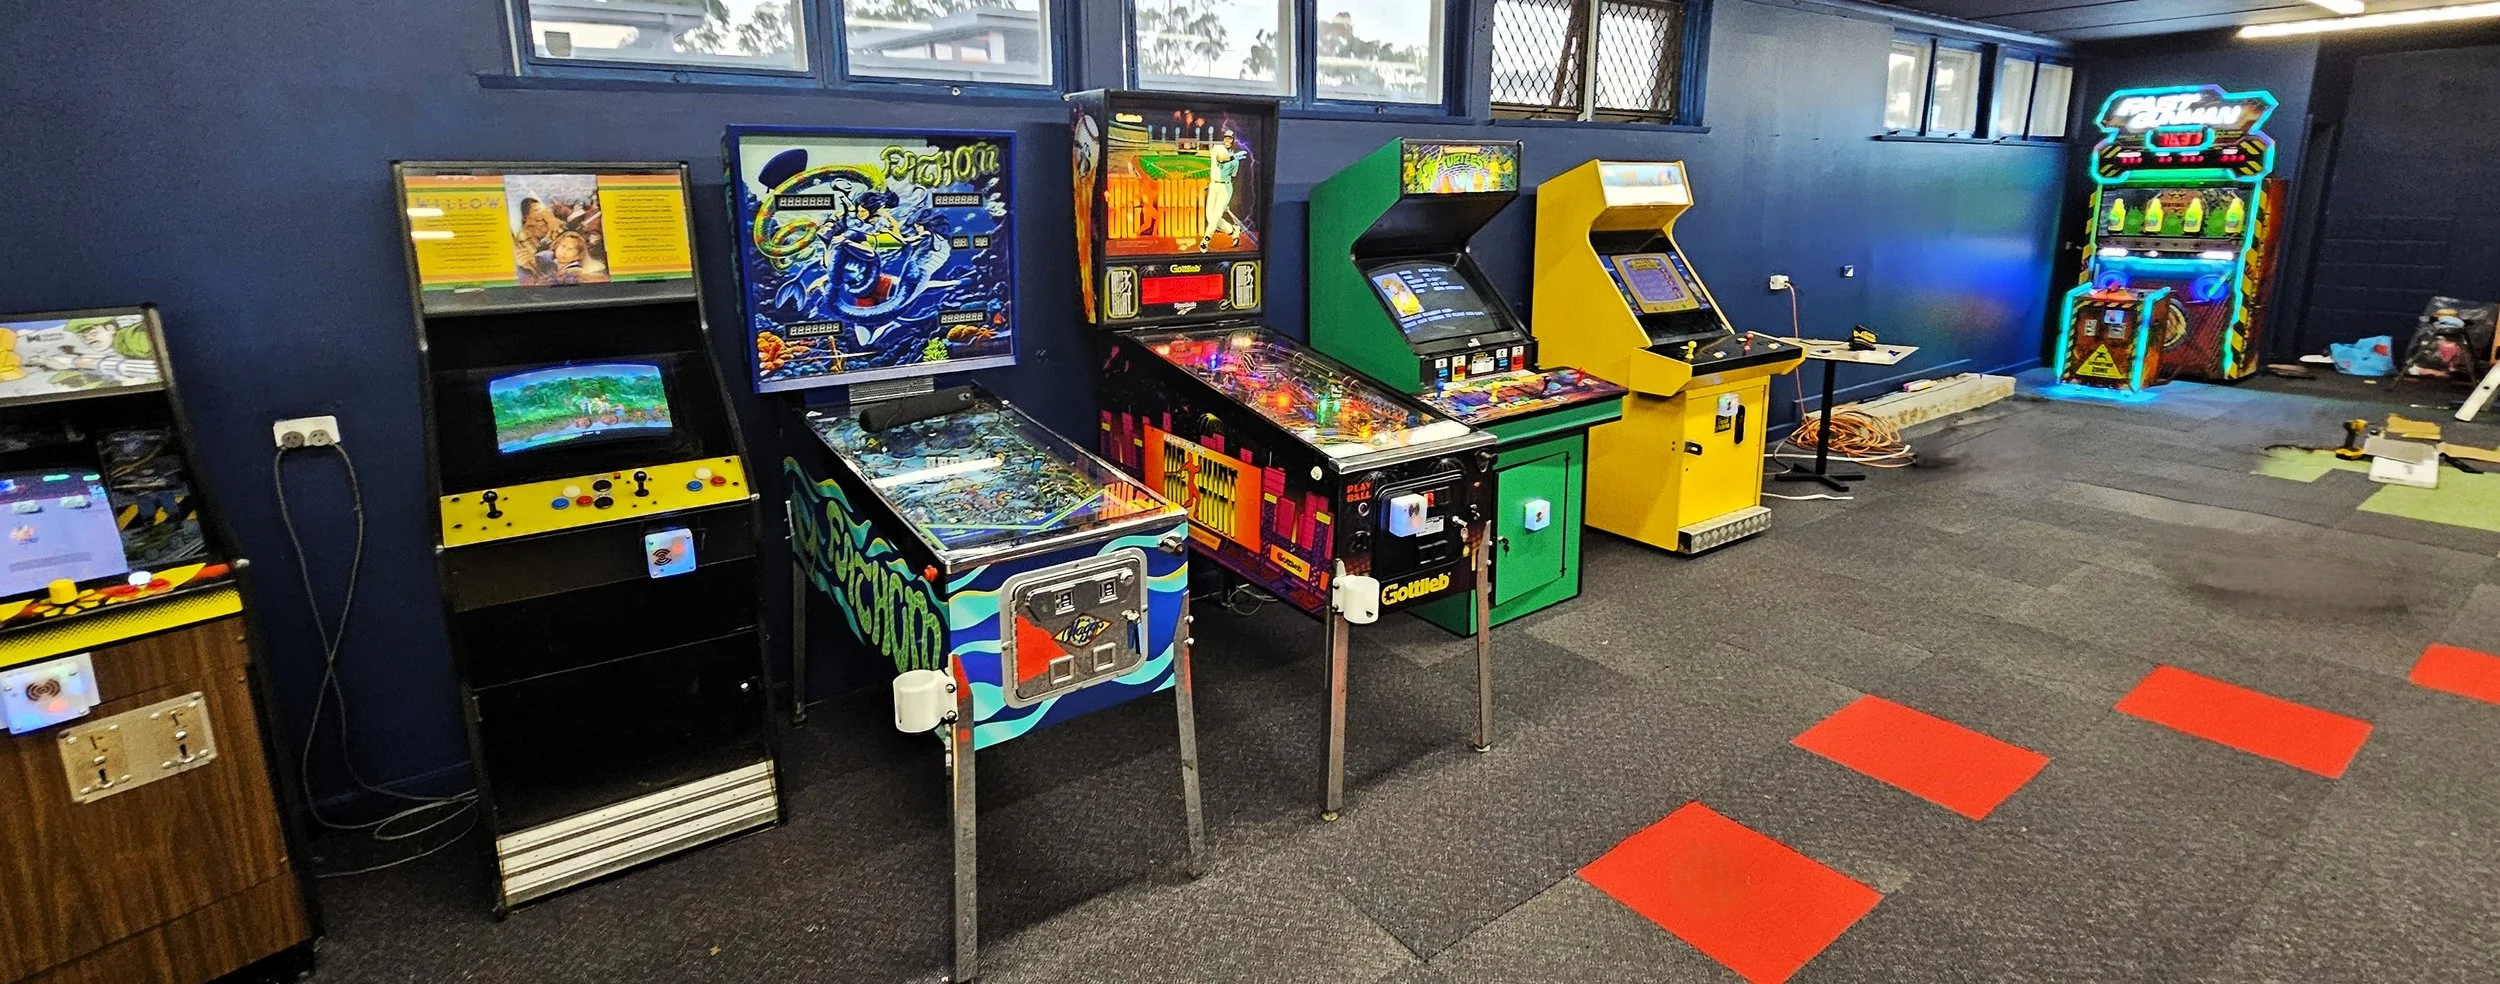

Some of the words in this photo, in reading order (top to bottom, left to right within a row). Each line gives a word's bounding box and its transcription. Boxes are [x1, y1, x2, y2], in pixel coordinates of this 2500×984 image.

[881, 142, 1000, 187] FATHOM
[1442, 154, 1484, 171] TURTLES
[1346, 481, 1371, 493] PLAY
[1346, 491, 1372, 503] BALL
[826, 500, 942, 674] FATHOM
[1381, 574, 1451, 606] Gottlieb
